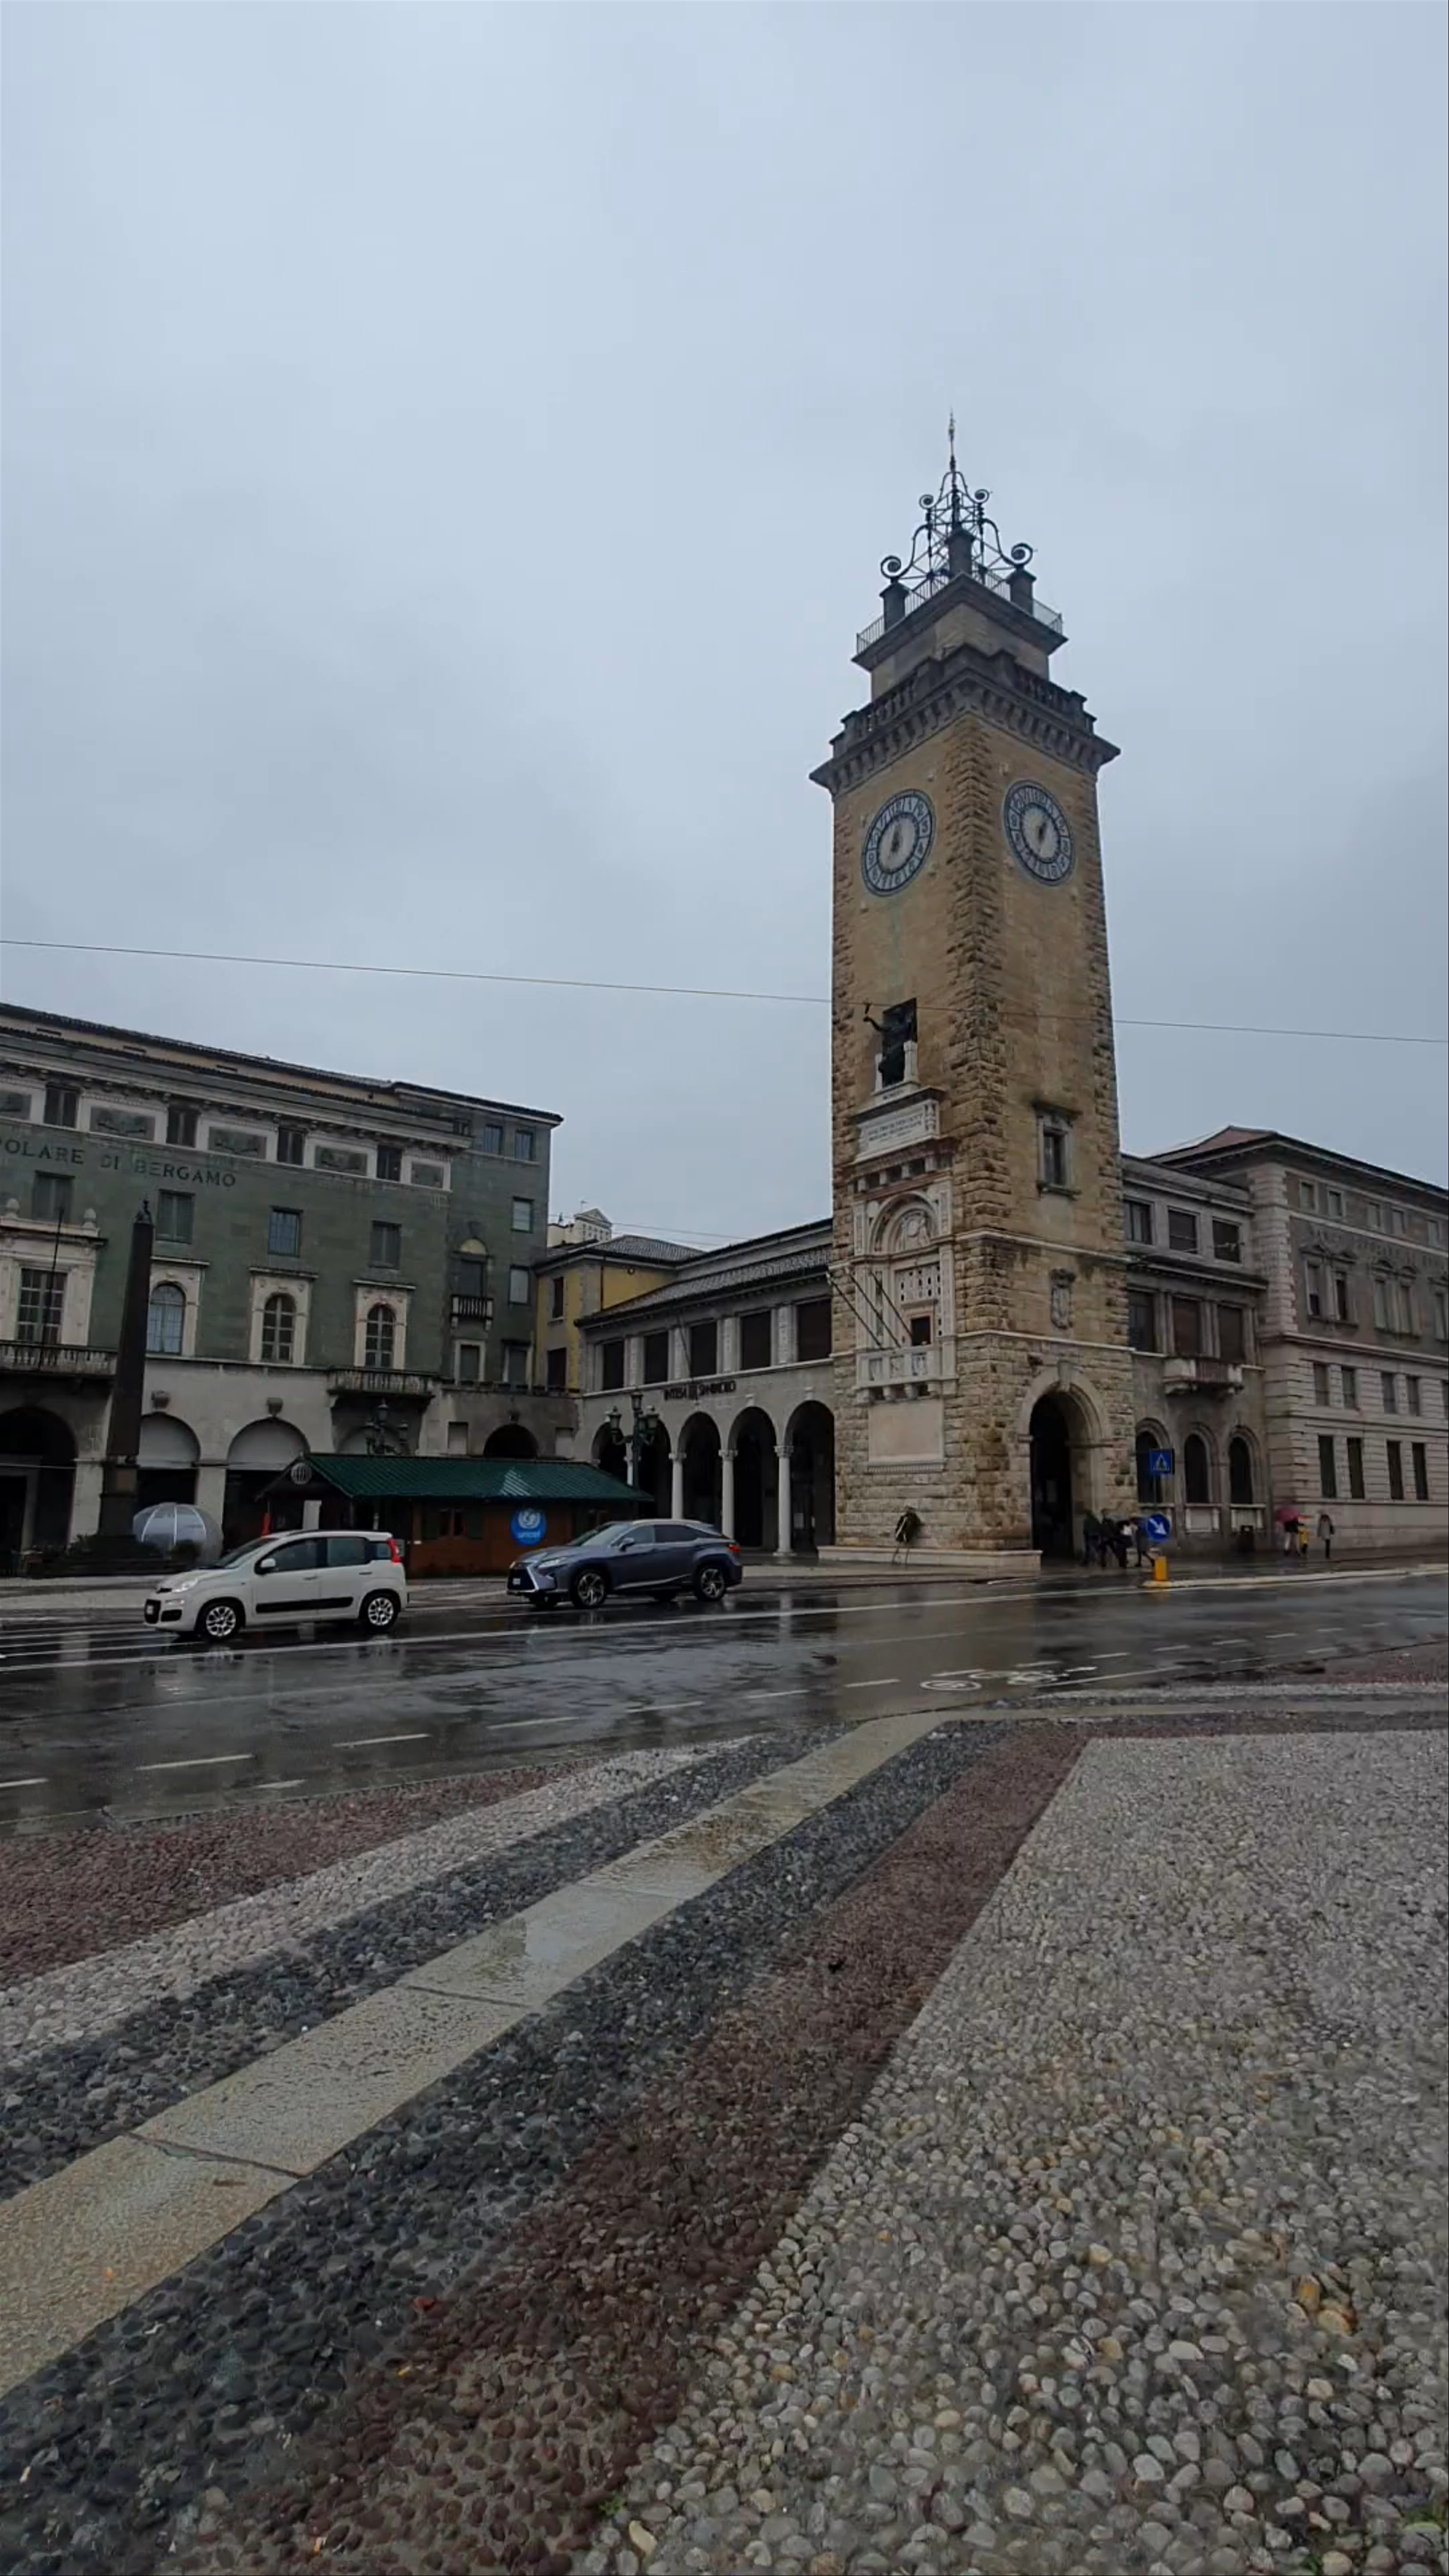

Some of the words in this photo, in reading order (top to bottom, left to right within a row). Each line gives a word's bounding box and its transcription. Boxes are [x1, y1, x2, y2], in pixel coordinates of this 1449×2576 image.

[0, 1137, 86, 1164] OLARE
[100, 1154, 118, 1170] DI
[134, 1158, 236, 1187] BERGAMO
